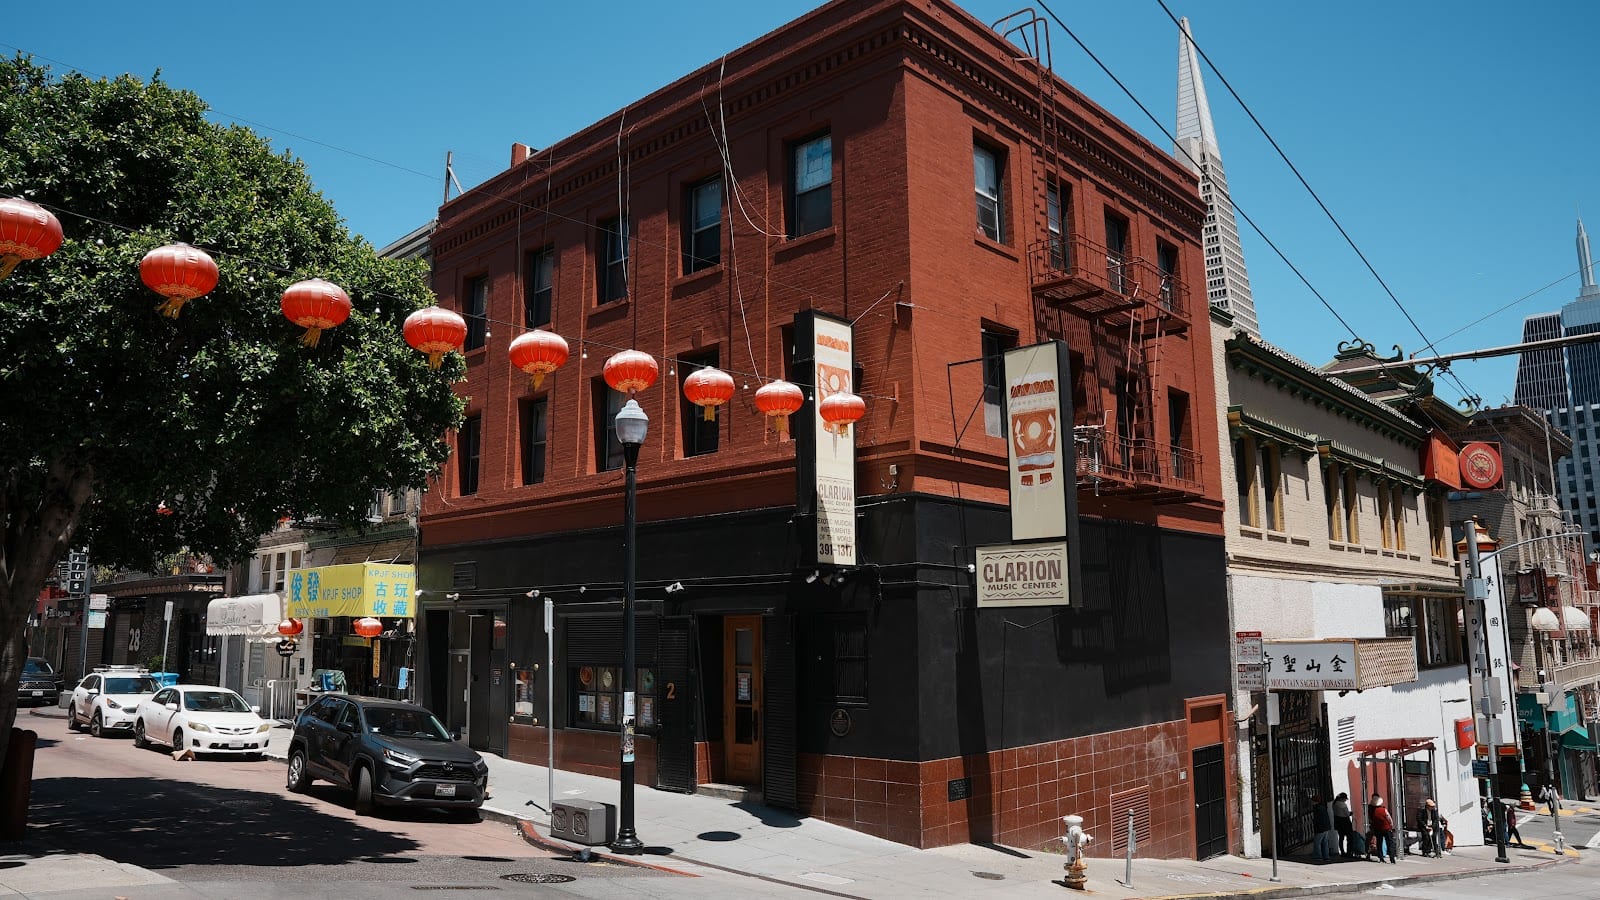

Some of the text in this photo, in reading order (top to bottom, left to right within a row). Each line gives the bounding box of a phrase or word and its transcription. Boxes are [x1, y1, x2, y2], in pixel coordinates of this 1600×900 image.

[818, 484, 853, 501] CLARION
[819, 543, 853, 557] 391-1317
[391, 571, 416, 579] SHOP
[983, 560, 1062, 583] CLARION
[322, 587, 362, 600] KPJF SHOP
[374, 581, 408, 598] 古玩
[987, 581, 1057, 591] MUSIC CENTER
[373, 600, 407, 616] 收藏
[128, 628, 140, 652] 28
[666, 682, 676, 699] 2
[1270, 679, 1299, 688] MOUNTAIN
[1300, 679, 1320, 688] SAGELY
[1321, 678, 1355, 687] MONASTERY
